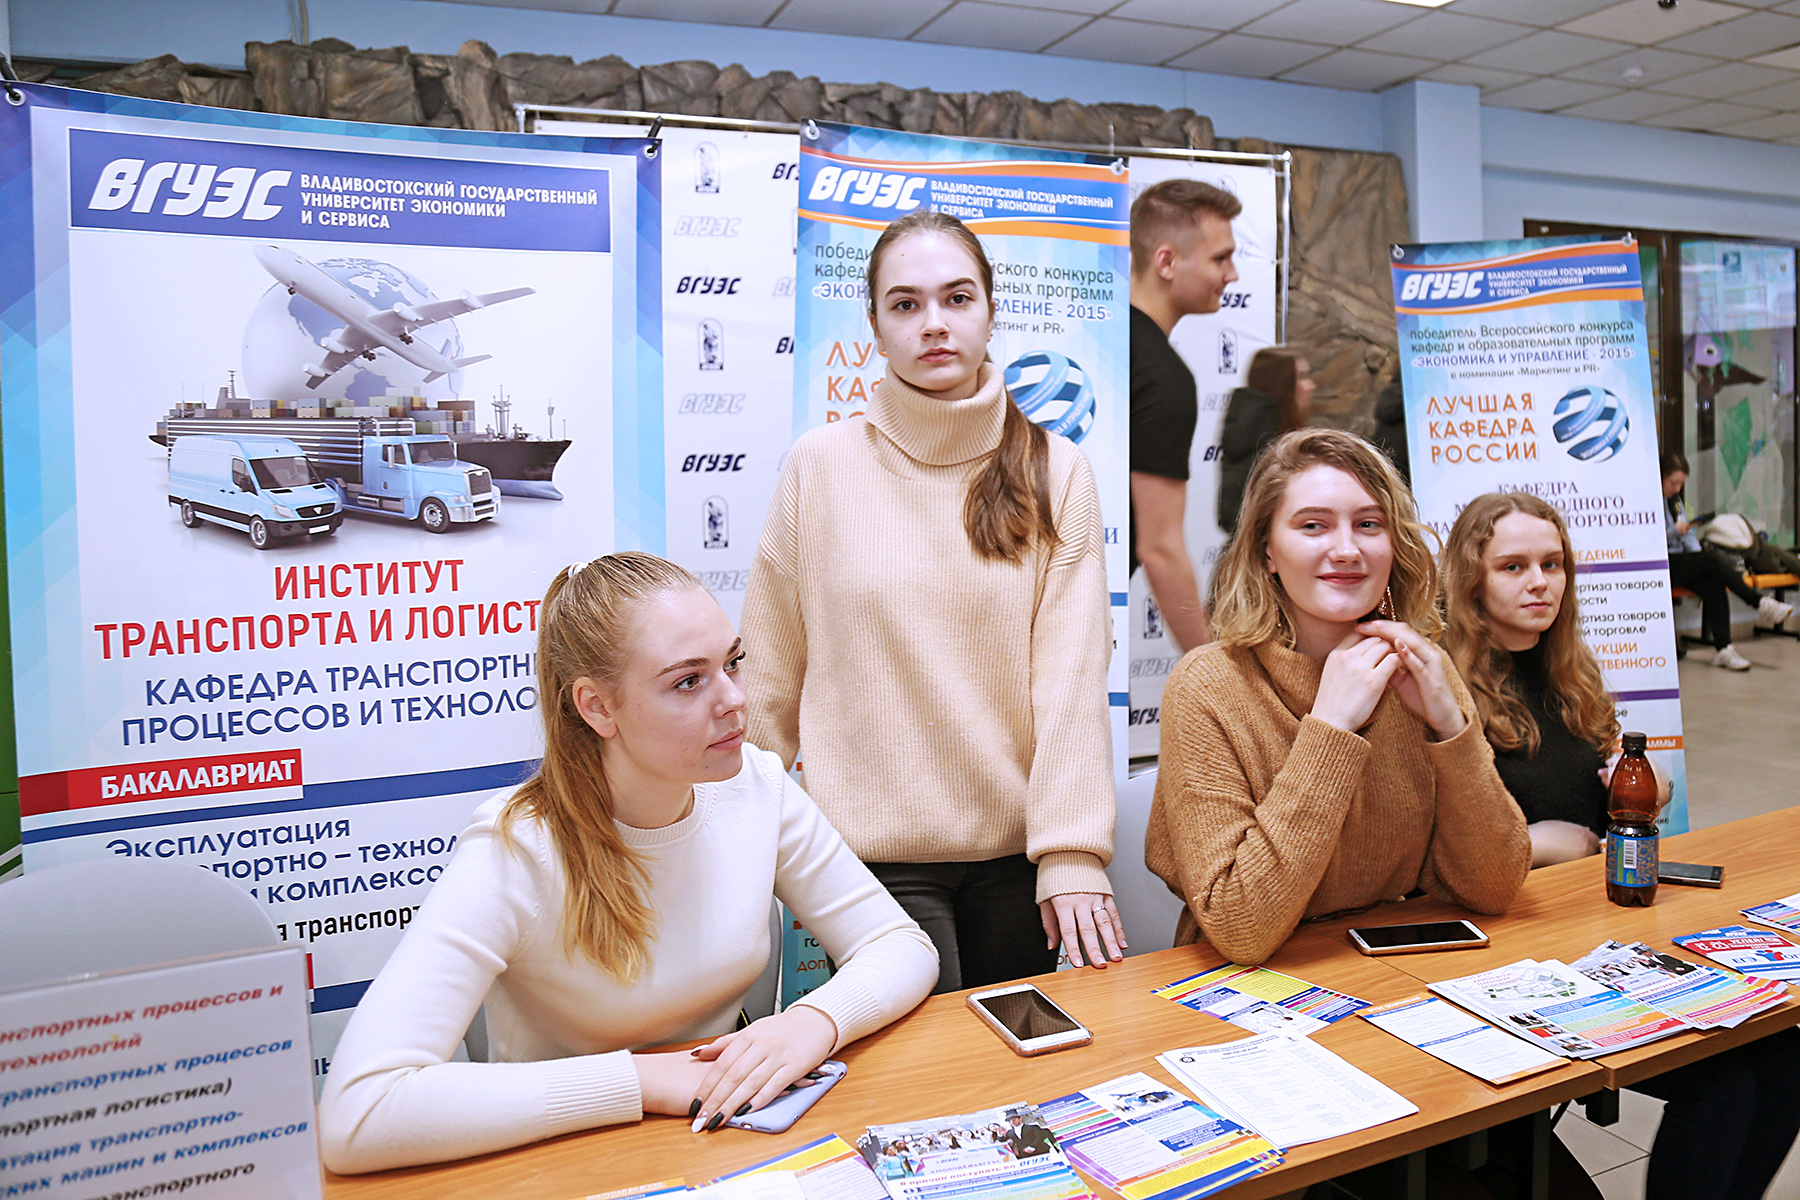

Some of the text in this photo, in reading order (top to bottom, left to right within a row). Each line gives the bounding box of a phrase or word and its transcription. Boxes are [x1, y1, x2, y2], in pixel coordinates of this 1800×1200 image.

[88, 157, 293, 221] ВГУЭС
[300, 174, 598, 205] ВЛАДИВОСТОКСКИЙ ГОСУДАРСТВЕННЫЙ
[808, 166, 927, 211] ВГУЭС
[931, 180, 1113, 208] ВЛАДИВОСТОКСКИЙ ГОСУДАРСТВЕННЫЙ
[301, 192, 506, 217] УНИВЕРСИТЕТ ЭКОНОМИКИ
[931, 192, 1056, 214] УНИВЕРСИТЕТ ЭКОНОМИКИ
[941, 205, 984, 218] СЕРВИСА
[301, 210, 390, 229] И СЕРВИСА
[815, 242, 872, 261] победи
[815, 261, 867, 280] кафед
[1037, 284, 1113, 301] программ
[1045, 267, 1113, 285] конкурса
[1488, 263, 1628, 280] ВЛАДИВОСТОКСКИЙ ГОСУДАРСТВЕННЫЙ
[1489, 276, 1584, 288] УНИВЕРСИТЕТ ЭКОНОМИКИ
[676, 276, 742, 295] ВГУЭС
[1401, 271, 1484, 300] ВГУЭС
[1497, 287, 1530, 297] СЕРВИСА
[994, 298, 1053, 316] ВЛЕНИЕ
[1221, 293, 1251, 308] УЭС
[994, 321, 1029, 332] етинг
[1410, 320, 1634, 340] победитель Всероссийского конкурса
[1411, 333, 1635, 354] кафедр и образовательных программ
[1499, 352, 1507, 363] И
[1511, 350, 1588, 364] УПРАВЛЕНИЕ
[1459, 369, 1515, 380] номинации
[1427, 393, 1533, 415] ЛУЧШАЯ
[1429, 418, 1536, 439] КАФЕДРА
[681, 453, 746, 473] ВГУЭС
[1432, 442, 1538, 463] РОССИИ
[1498, 481, 1579, 497] КАФЕДРА
[1566, 511, 1657, 529] ТОРГОВЛИ
[274, 559, 464, 600] ИНСТИТУТ
[1615, 580, 1664, 591] товаров
[1618, 611, 1667, 621] товаров
[94, 600, 541, 660] ТРАНСПОРТА И ЛОГИСТ
[1594, 626, 1646, 637] торговле
[1593, 642, 1638, 655] УКЦИИ
[1600, 656, 1666, 670] ТВЕННОГО
[146, 653, 537, 706] КАФЕДРА ТРАНСПОРТН
[123, 686, 538, 746] ПРОЦЕССОВ И ТЕХНОЛО
[1129, 707, 1159, 726] ВГУ
[101, 759, 296, 799] БАКАЛАВРИАТ
[106, 819, 351, 858] Эксплуатация
[199, 850, 327, 882] портно
[358, 835, 457, 863] технол
[267, 864, 444, 904] комплексо
[294, 905, 421, 943] транспор
[0, 983, 284, 1044] нспортных процессов и
[0, 1060, 167, 1108] ранспортных
[174, 1038, 294, 1073] процессов
[0, 1077, 233, 1137] портная логистика)
[0, 1110, 244, 1171] атация транспортно-
[61, 1120, 309, 1185] машин и комплексов
